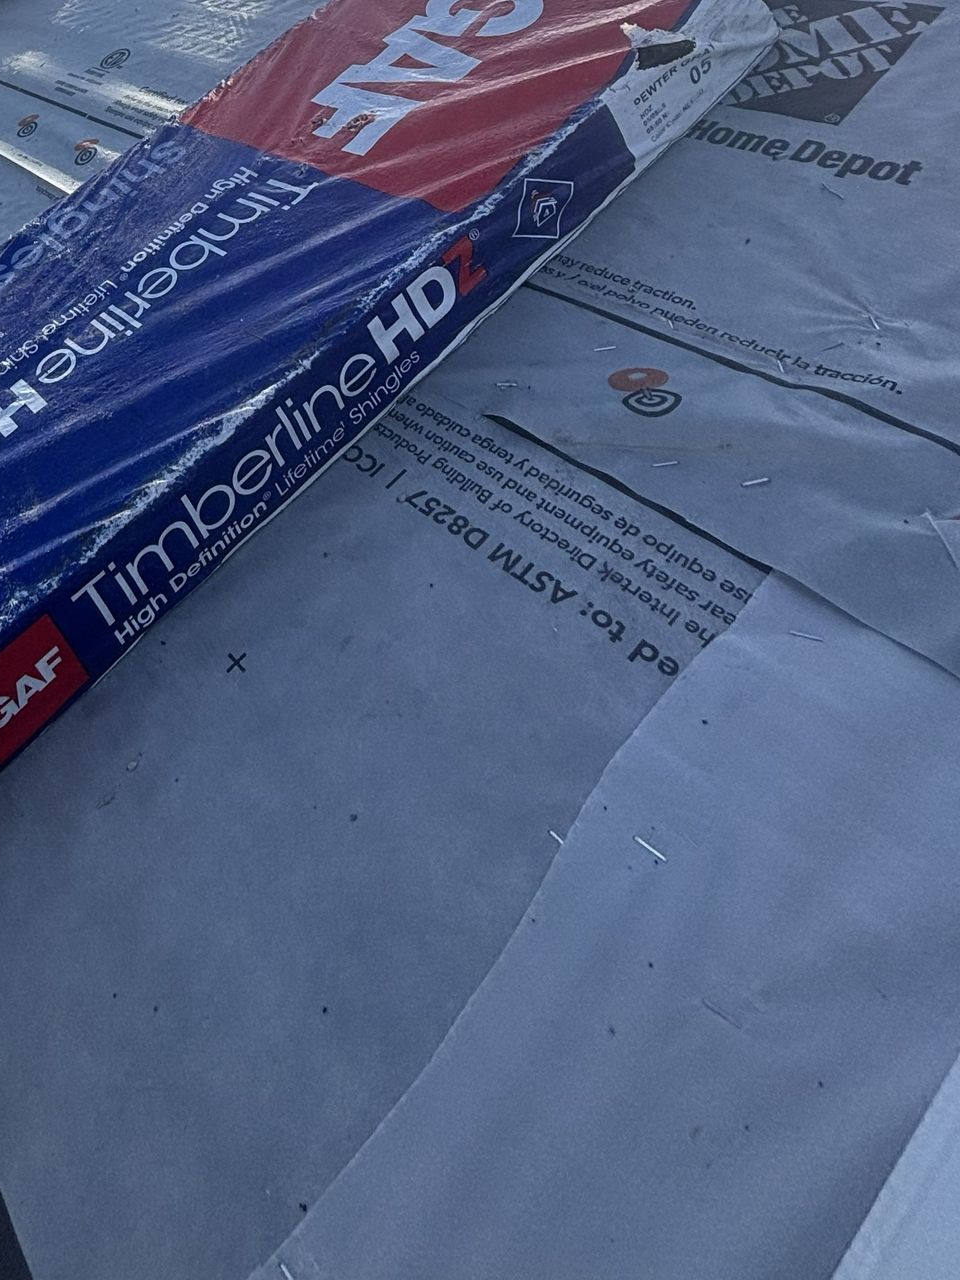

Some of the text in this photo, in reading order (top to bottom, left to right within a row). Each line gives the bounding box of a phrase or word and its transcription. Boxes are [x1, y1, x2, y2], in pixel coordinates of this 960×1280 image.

[689, 58, 712, 85] 05
[684, 118, 790, 160] Home
[789, 138, 924, 187] Depot
[203, 165, 259, 204] High
[36, 175, 320, 385] Timberline
[580, 260, 631, 286] reduce
[632, 279, 697, 311] traction.
[604, 288, 651, 310] polvo
[649, 305, 719, 336] pueden
[718, 331, 792, 362] reducir
[791, 356, 811, 371] la
[814, 364, 903, 395] tracción.
[372, 421, 434, 466] Products
[415, 403, 472, 436] cuidado
[424, 430, 477, 464] caution
[471, 433, 515, 465] tenga
[512, 457, 530, 473] y
[70, 352, 379, 627] Timberline
[431, 457, 494, 505] Building
[475, 460, 505, 483] use
[500, 478, 538, 502] and
[527, 463, 615, 522] seguridad
[114, 592, 168, 646] High
[350, 349, 422, 426] Shingles
[403, 489, 491, 551] D8257
[488, 500, 514, 515] of
[513, 510, 598, 571] Directory
[536, 495, 636, 561] equipment
[614, 516, 641, 538] de
[487, 541, 579, 605] ASTM
[633, 558, 701, 602] safety
[642, 533, 717, 582] equipo
[597, 561, 681, 627] Intertek
[579, 601, 626, 644] to:
